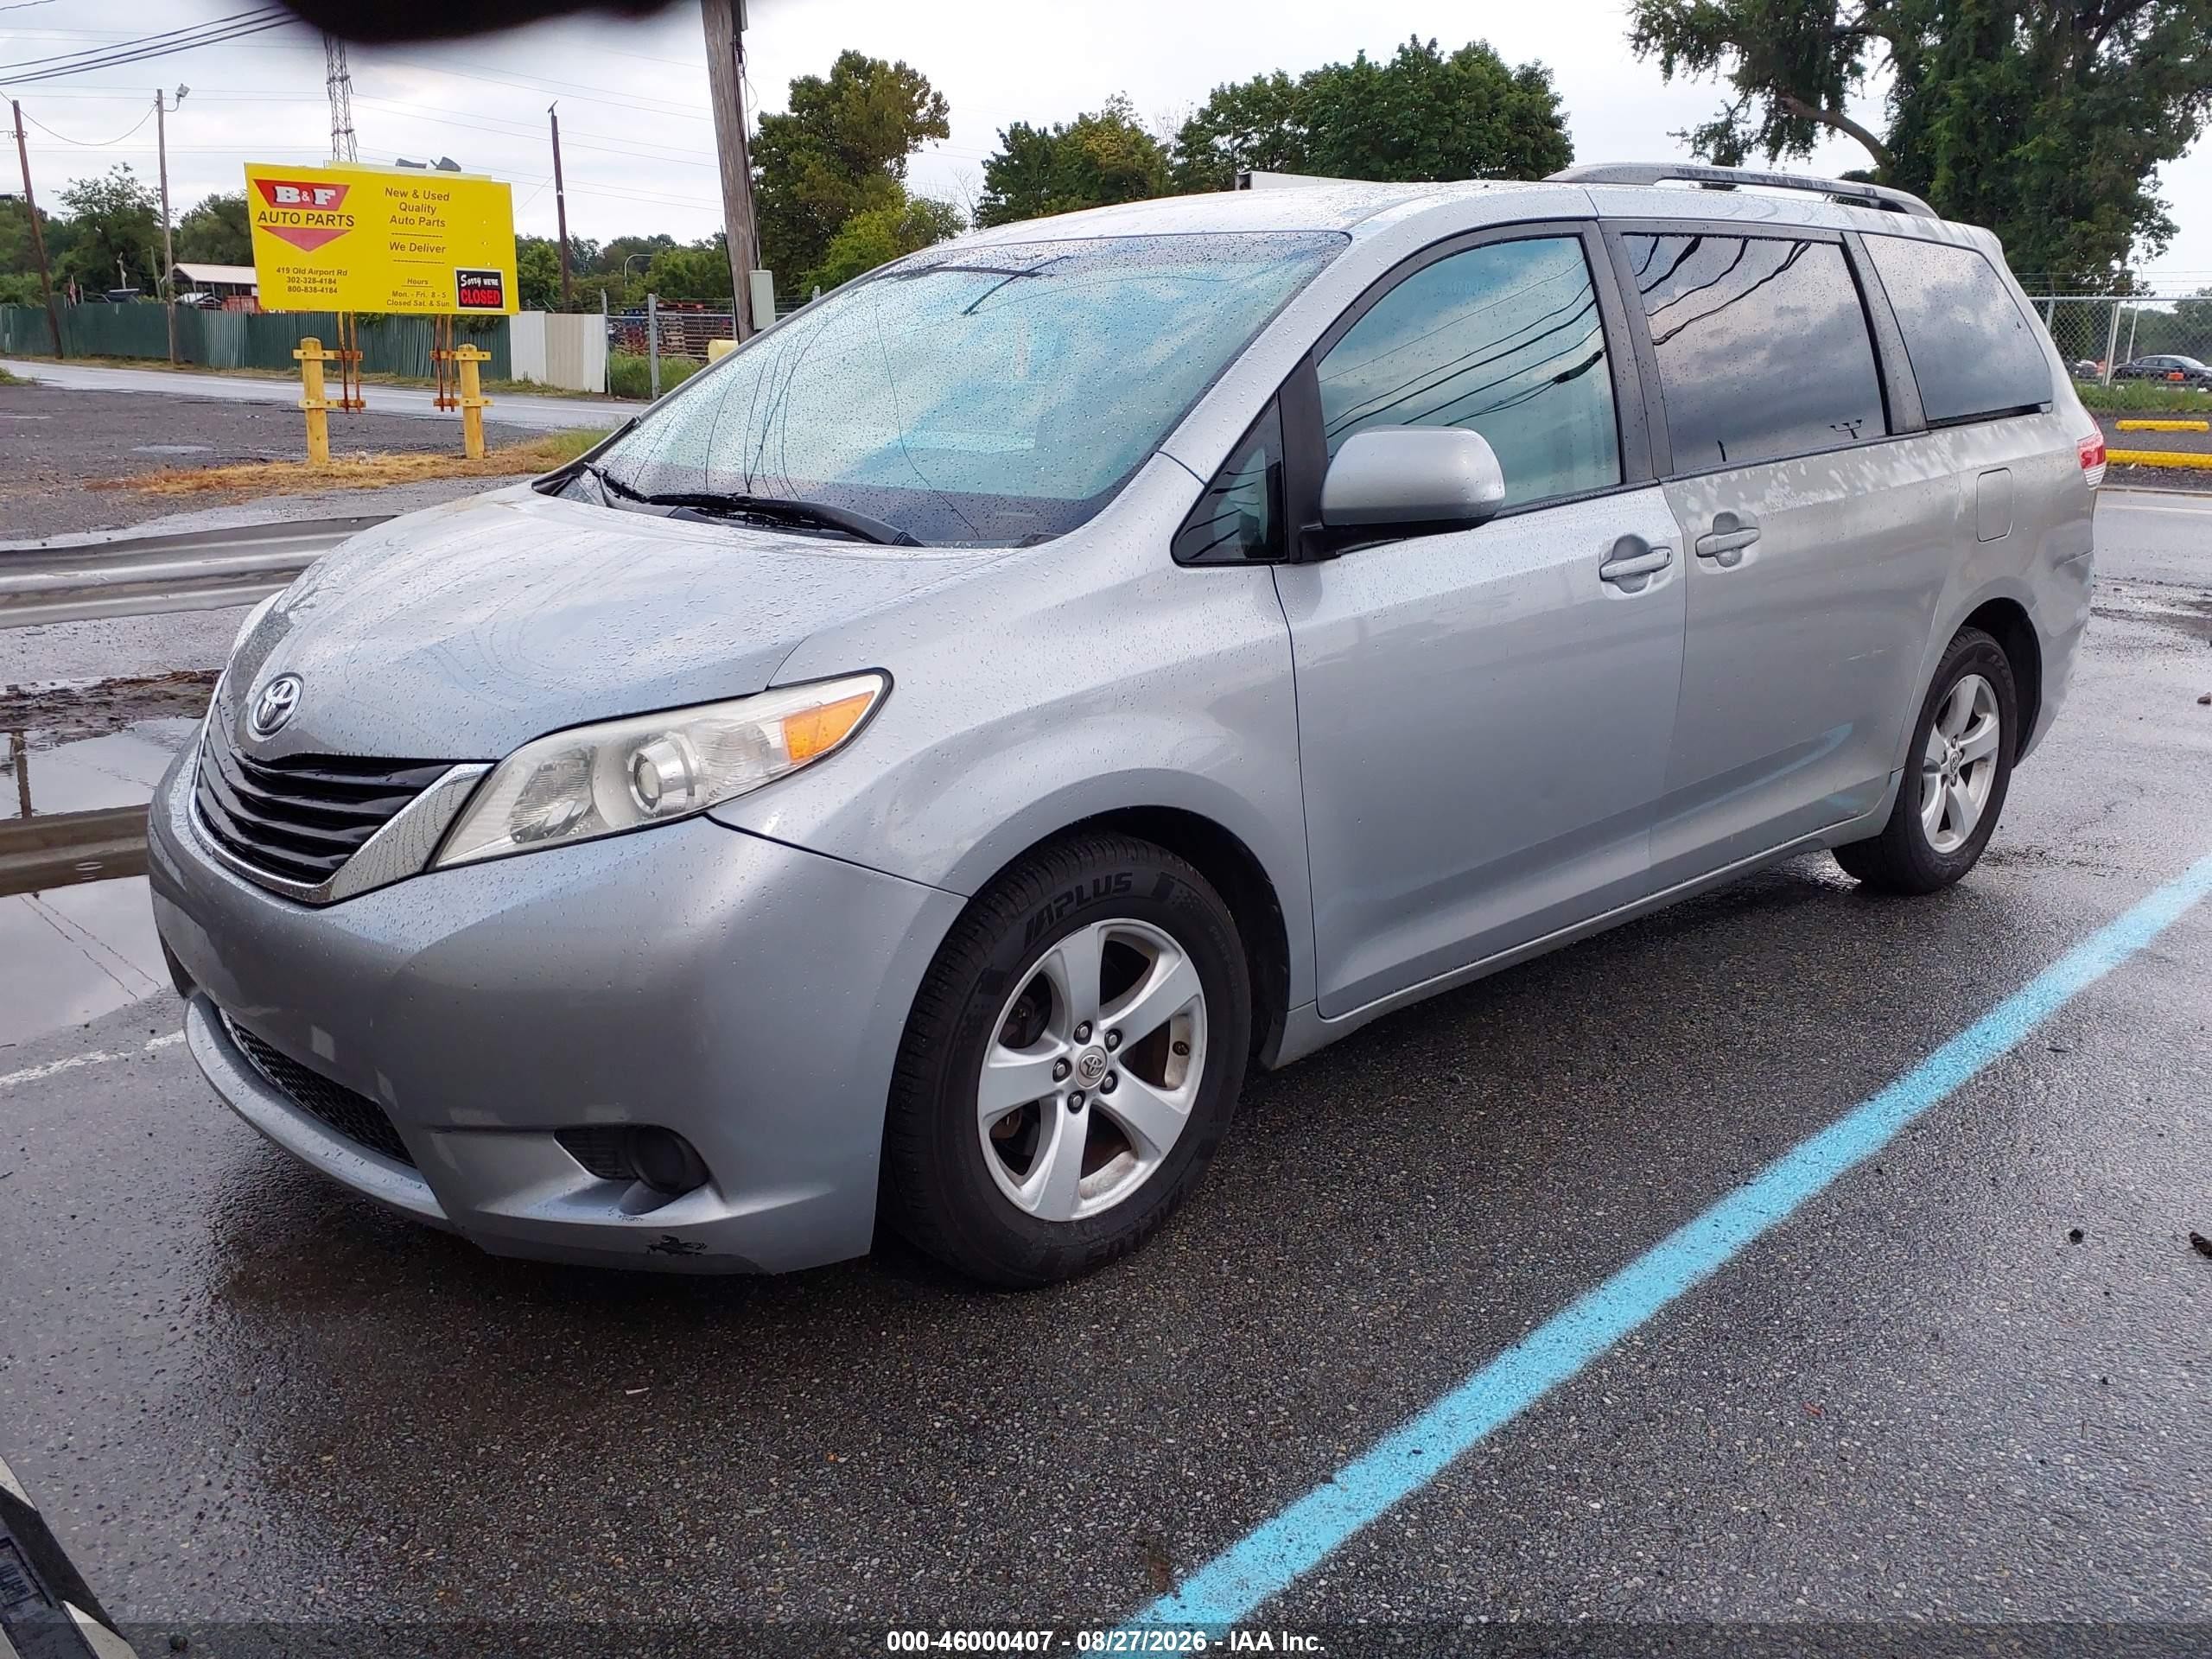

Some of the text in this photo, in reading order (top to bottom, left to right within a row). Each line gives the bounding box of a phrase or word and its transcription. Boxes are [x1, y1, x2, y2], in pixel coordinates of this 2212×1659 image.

[385, 187, 450, 201] New & Used
[399, 201, 436, 216] Quality
[257, 211, 355, 227] AUTO PARTS
[390, 214, 446, 227] Auto Parts
[390, 241, 447, 254] We Deliver
[276, 266, 290, 275] 419
[292, 267, 306, 276] Old
[308, 268, 335, 277] Airport
[286, 276, 337, 285] 302-328-4184
[461, 274, 482, 288] Sorry
[460, 289, 500, 305] CLOSED
